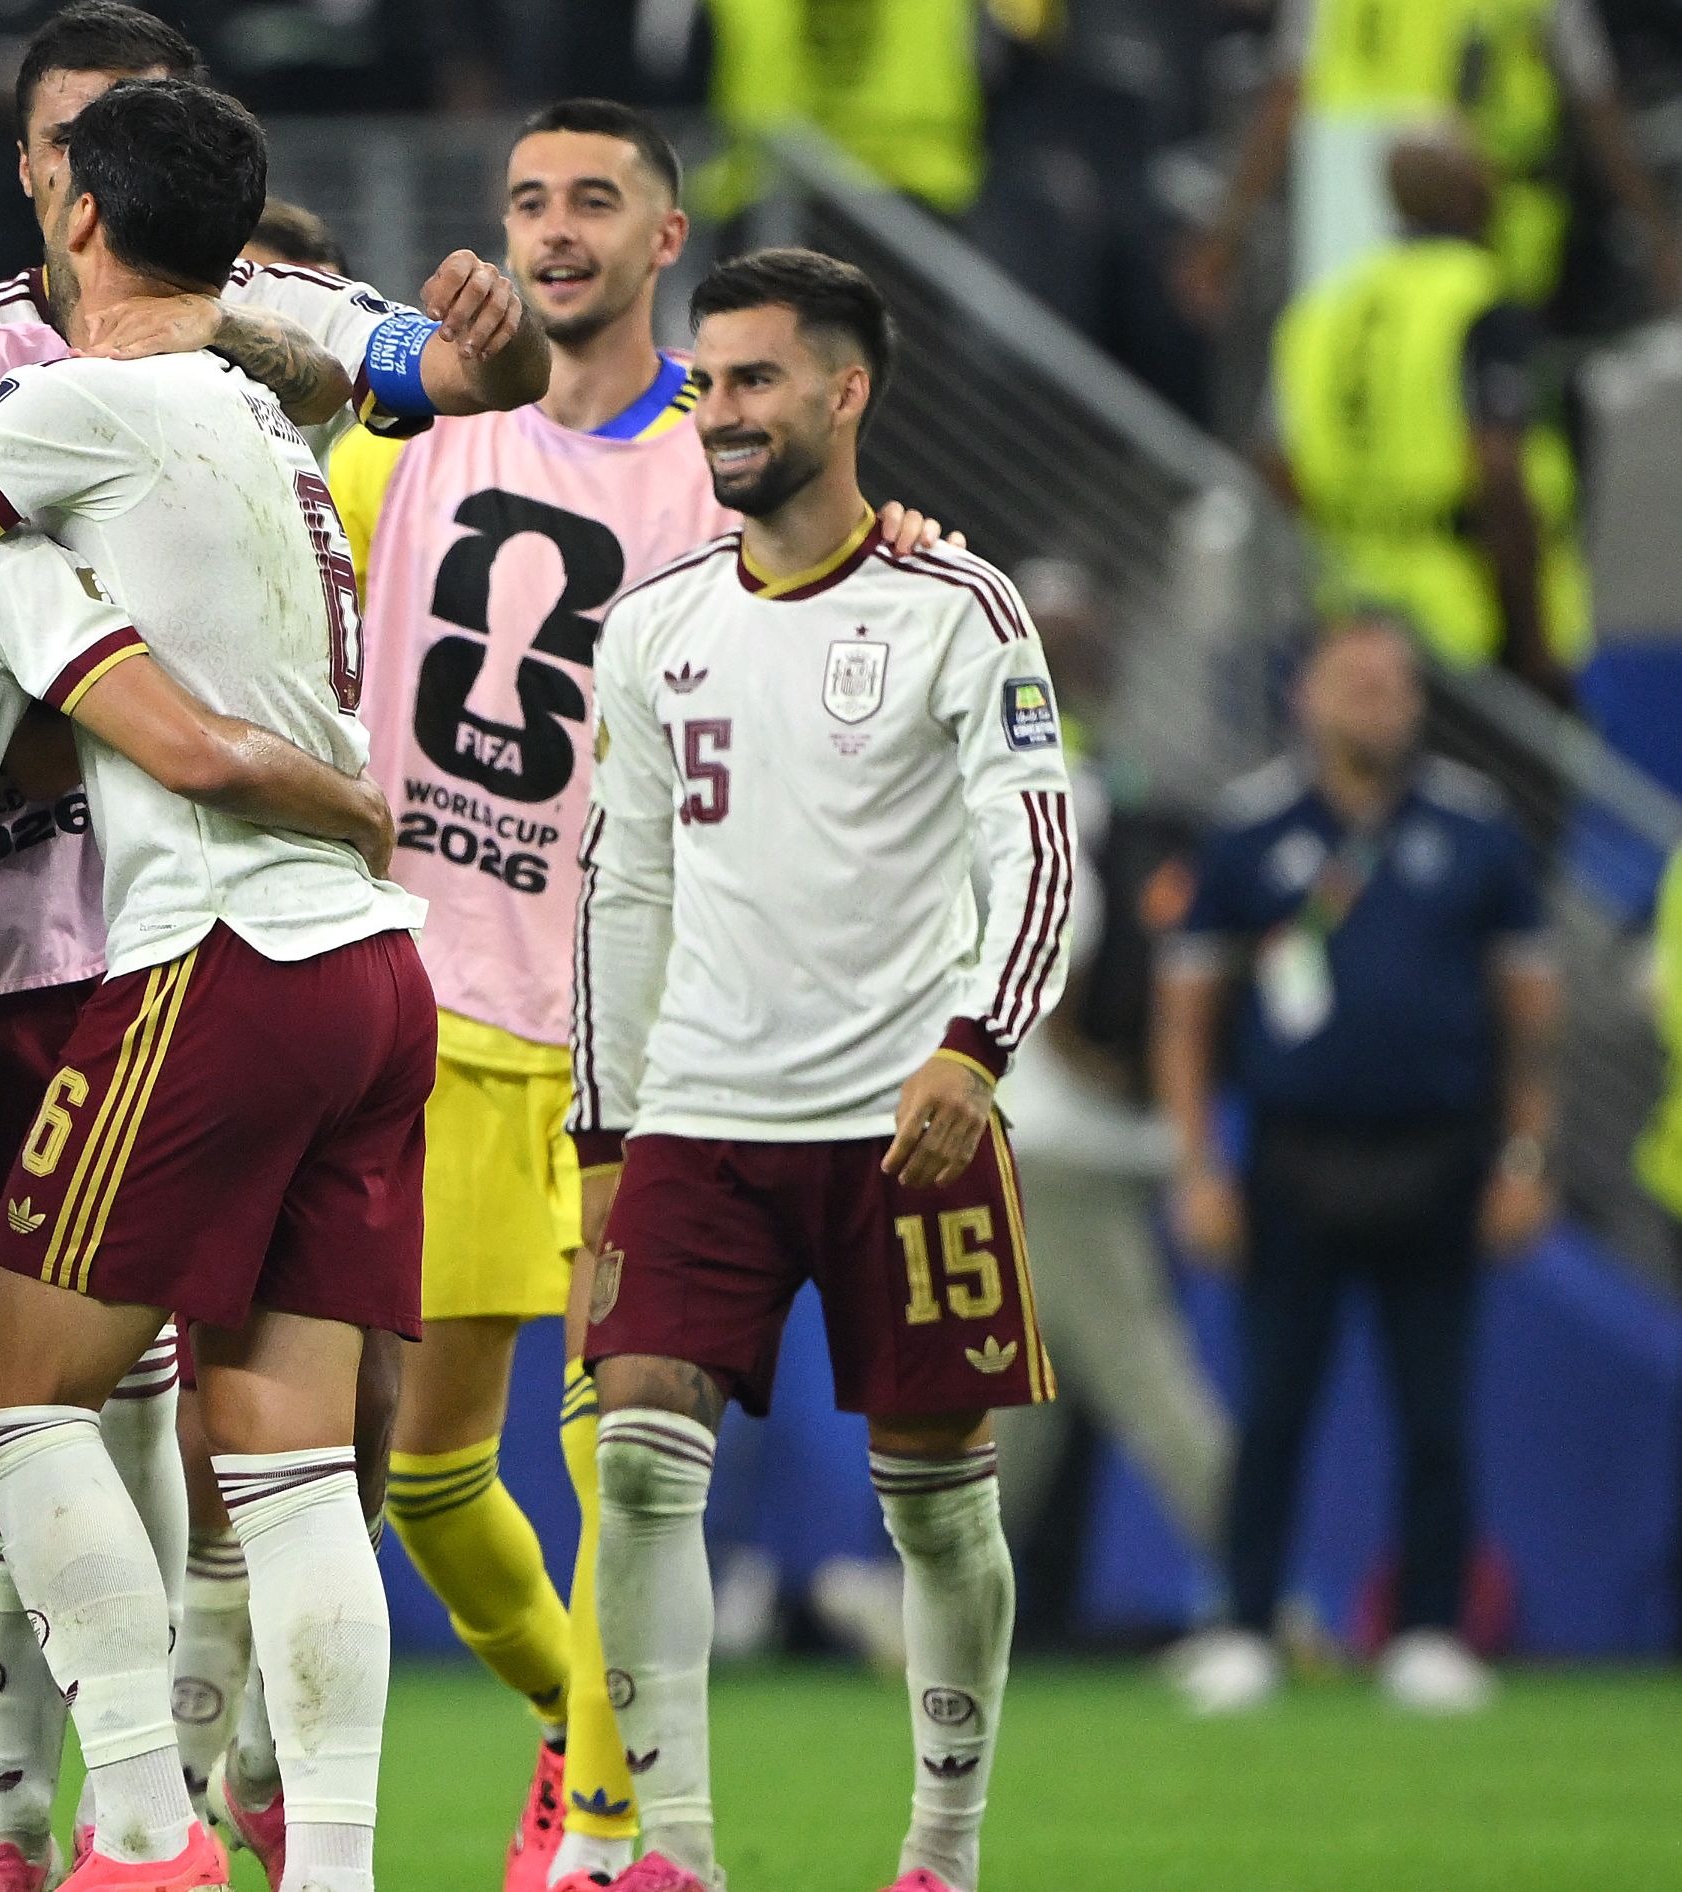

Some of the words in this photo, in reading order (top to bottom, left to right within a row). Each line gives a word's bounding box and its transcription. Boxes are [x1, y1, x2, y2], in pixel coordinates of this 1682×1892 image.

[455, 721, 524, 777] FIFA
[397, 812, 549, 894] 2026
[497, 814, 560, 849] CUP
[22, 1065, 90, 1178] 6
[894, 1205, 1003, 1325] 15
